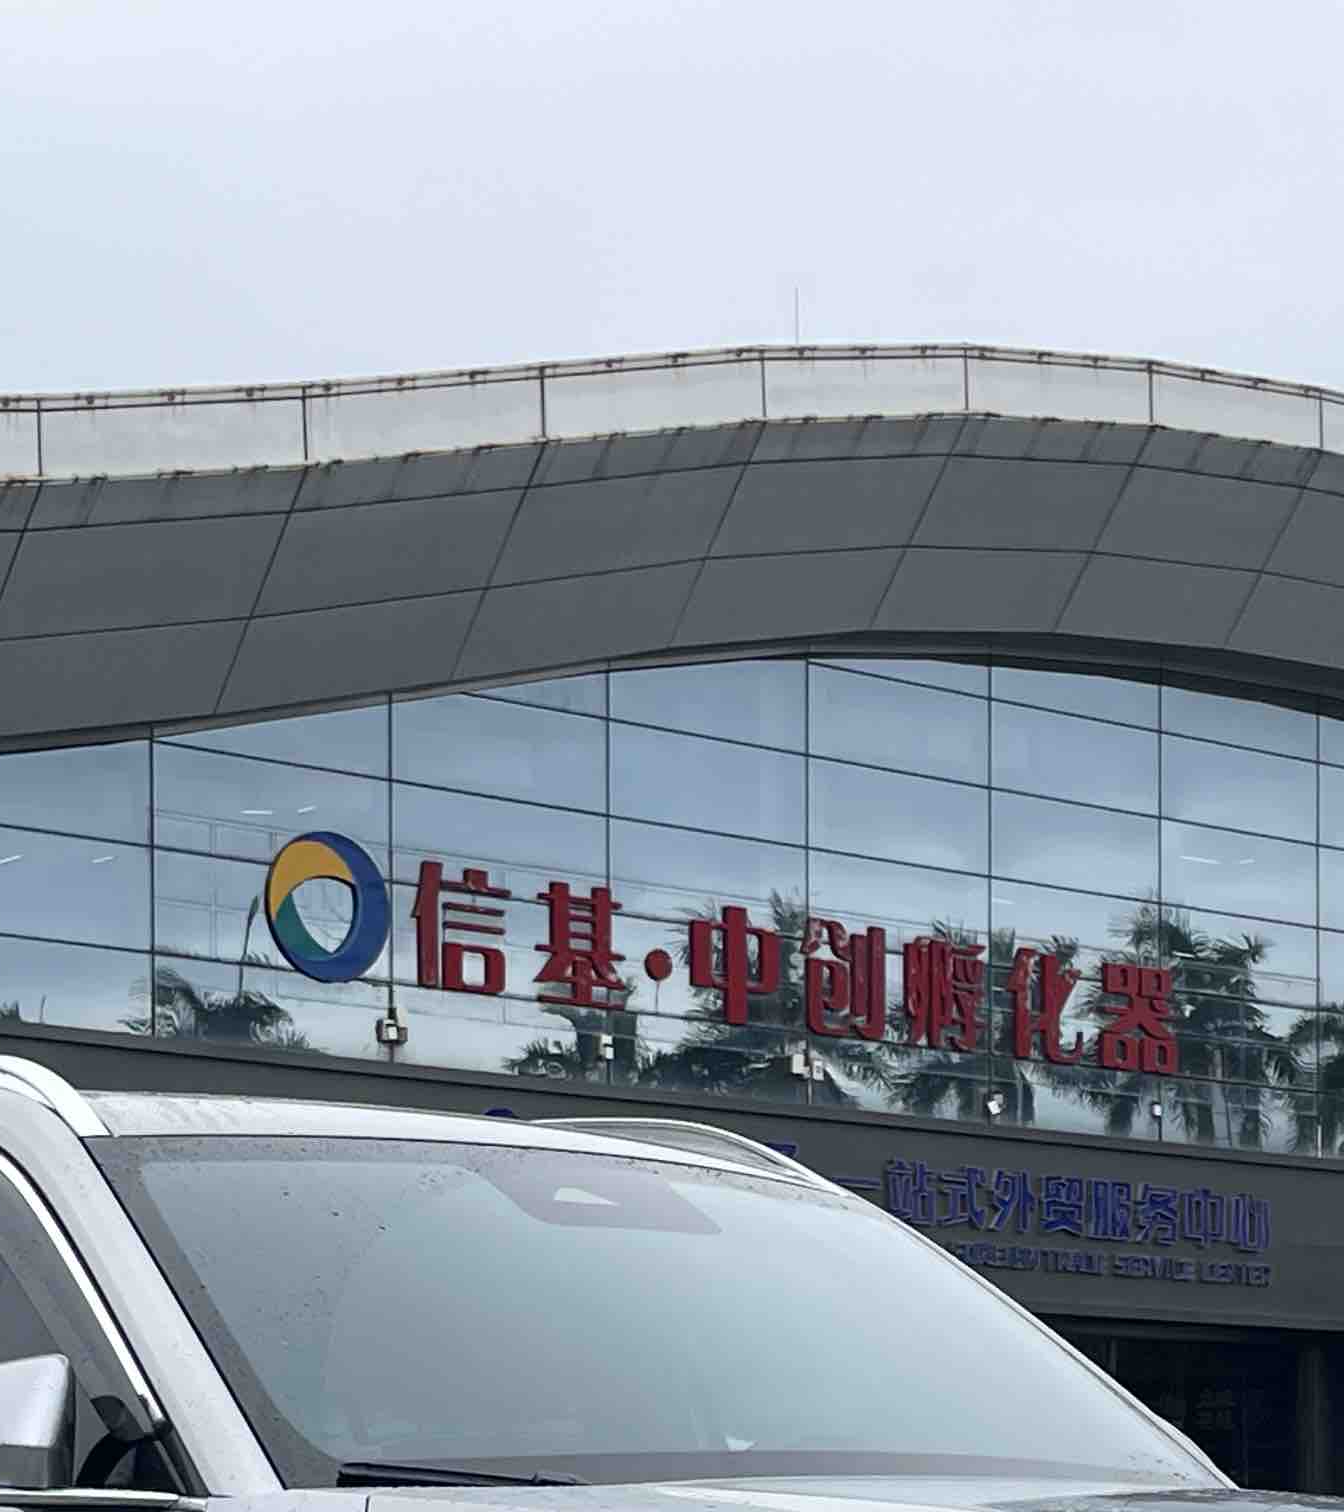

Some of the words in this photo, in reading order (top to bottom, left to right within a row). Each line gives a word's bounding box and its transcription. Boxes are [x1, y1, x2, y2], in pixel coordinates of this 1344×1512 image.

[411, 860, 1179, 1075] 信基·中创孵化器
